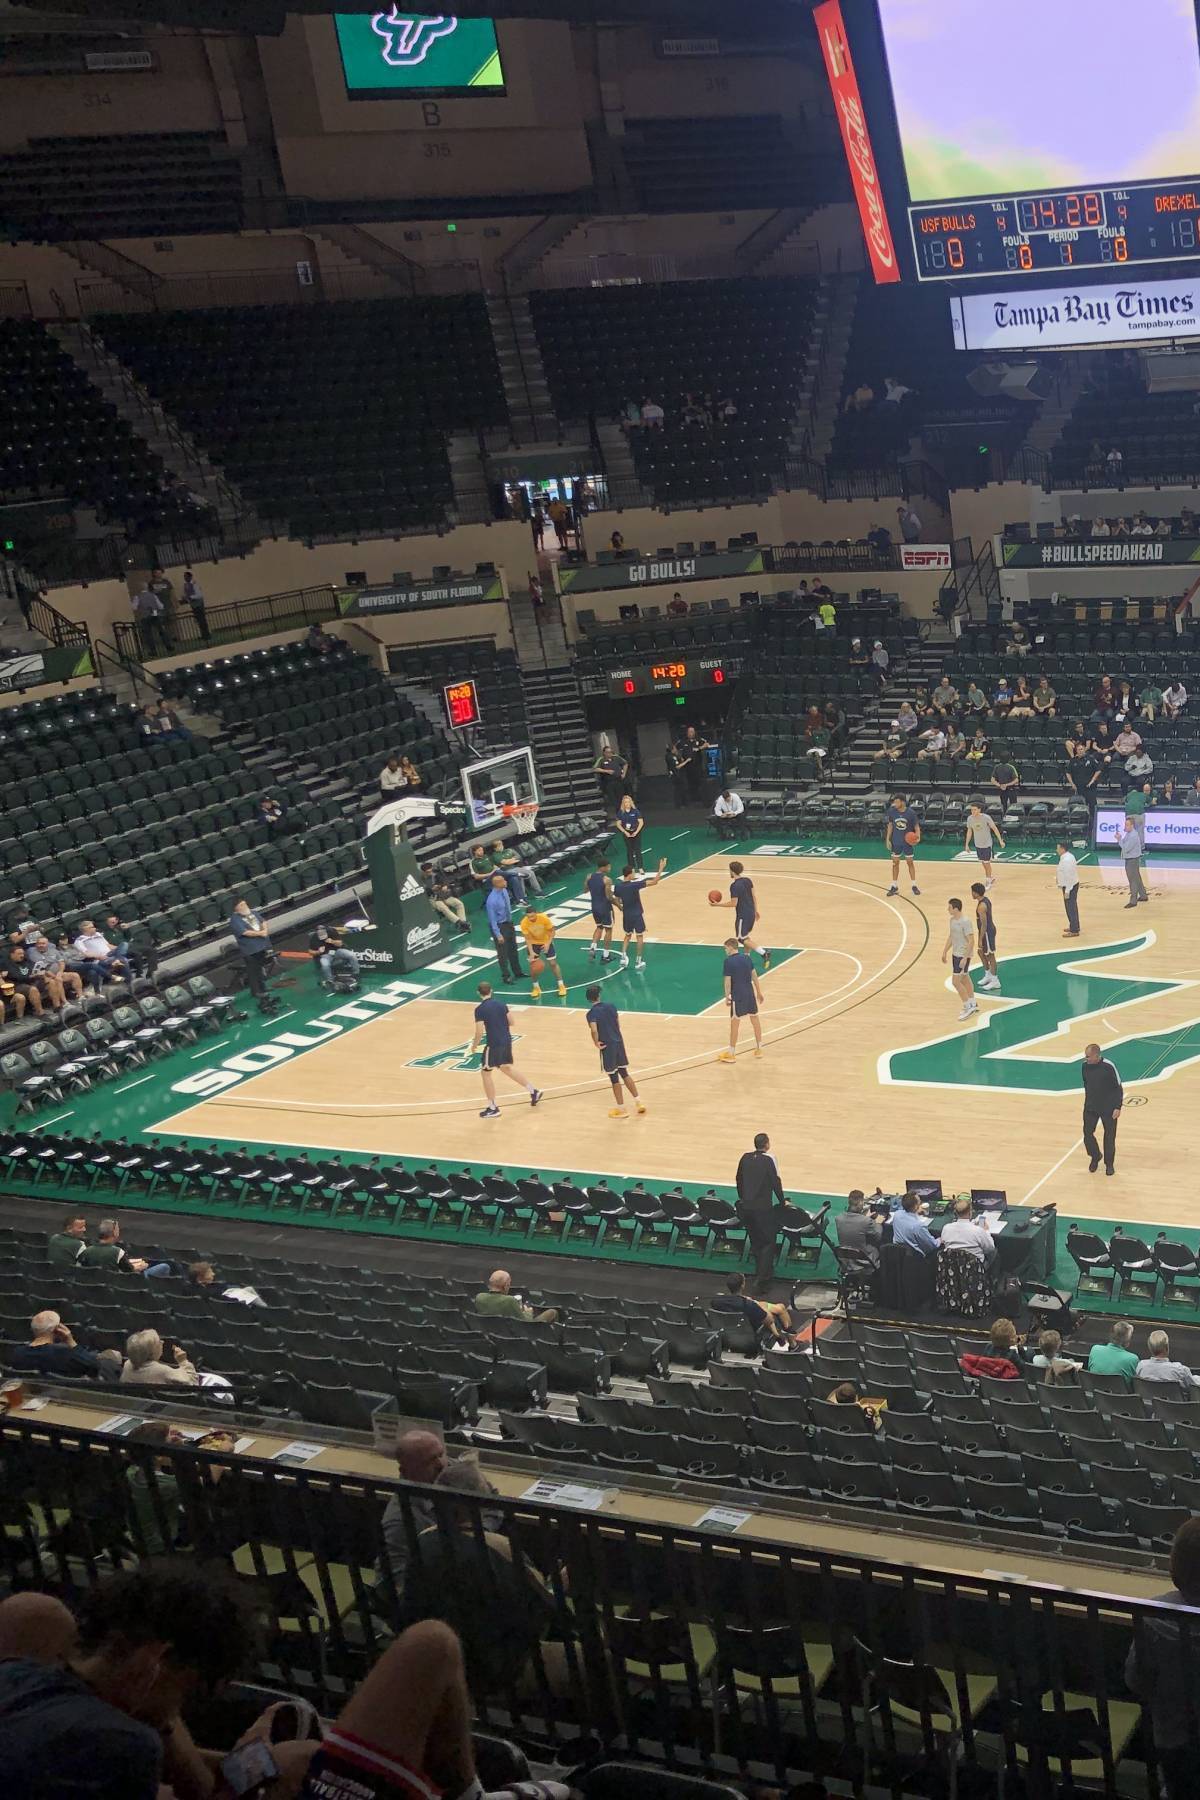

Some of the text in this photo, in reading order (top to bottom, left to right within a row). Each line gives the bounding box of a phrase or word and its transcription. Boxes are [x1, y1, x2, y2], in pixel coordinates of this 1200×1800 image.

[422, 102, 442, 128] B
[1154, 193, 1200, 213] DREXEL
[1117, 206, 1127, 220] 4
[996, 217, 1006, 231] 4
[1048, 231, 1079, 243] PERIOD
[1098, 226, 1126, 239] FOULS
[1002, 234, 1030, 247] FOULS
[947, 237, 964, 268] 0
[1019, 244, 1033, 270] 0
[1114, 237, 1128, 262] 0
[994, 301, 1060, 334] Tampa
[1064, 295, 1110, 326] Bay
[1116, 290, 1194, 318] Times
[1127, 316, 1196, 331] tampabay.com
[904, 551, 949, 566] ESPN
[1041, 543, 1163, 563] #BULLSPEEDAHEAD
[629, 560, 696, 582] GO BULLS!
[358, 585, 483, 608] UNIVERSITY OF SOUTH FLORIDA
[652, 664, 685, 679] 14:28
[700, 659, 723, 669] GUEST
[611, 670, 632, 680] HOME
[714, 670, 724, 684] 0
[624, 680, 634, 693] 0
[1099, 822, 1120, 833] Get
[1165, 824, 1200, 835] Home
[785, 845, 852, 857] USF
[400, 887, 425, 901] adidas
[170, 980, 432, 1096] SOUTH
